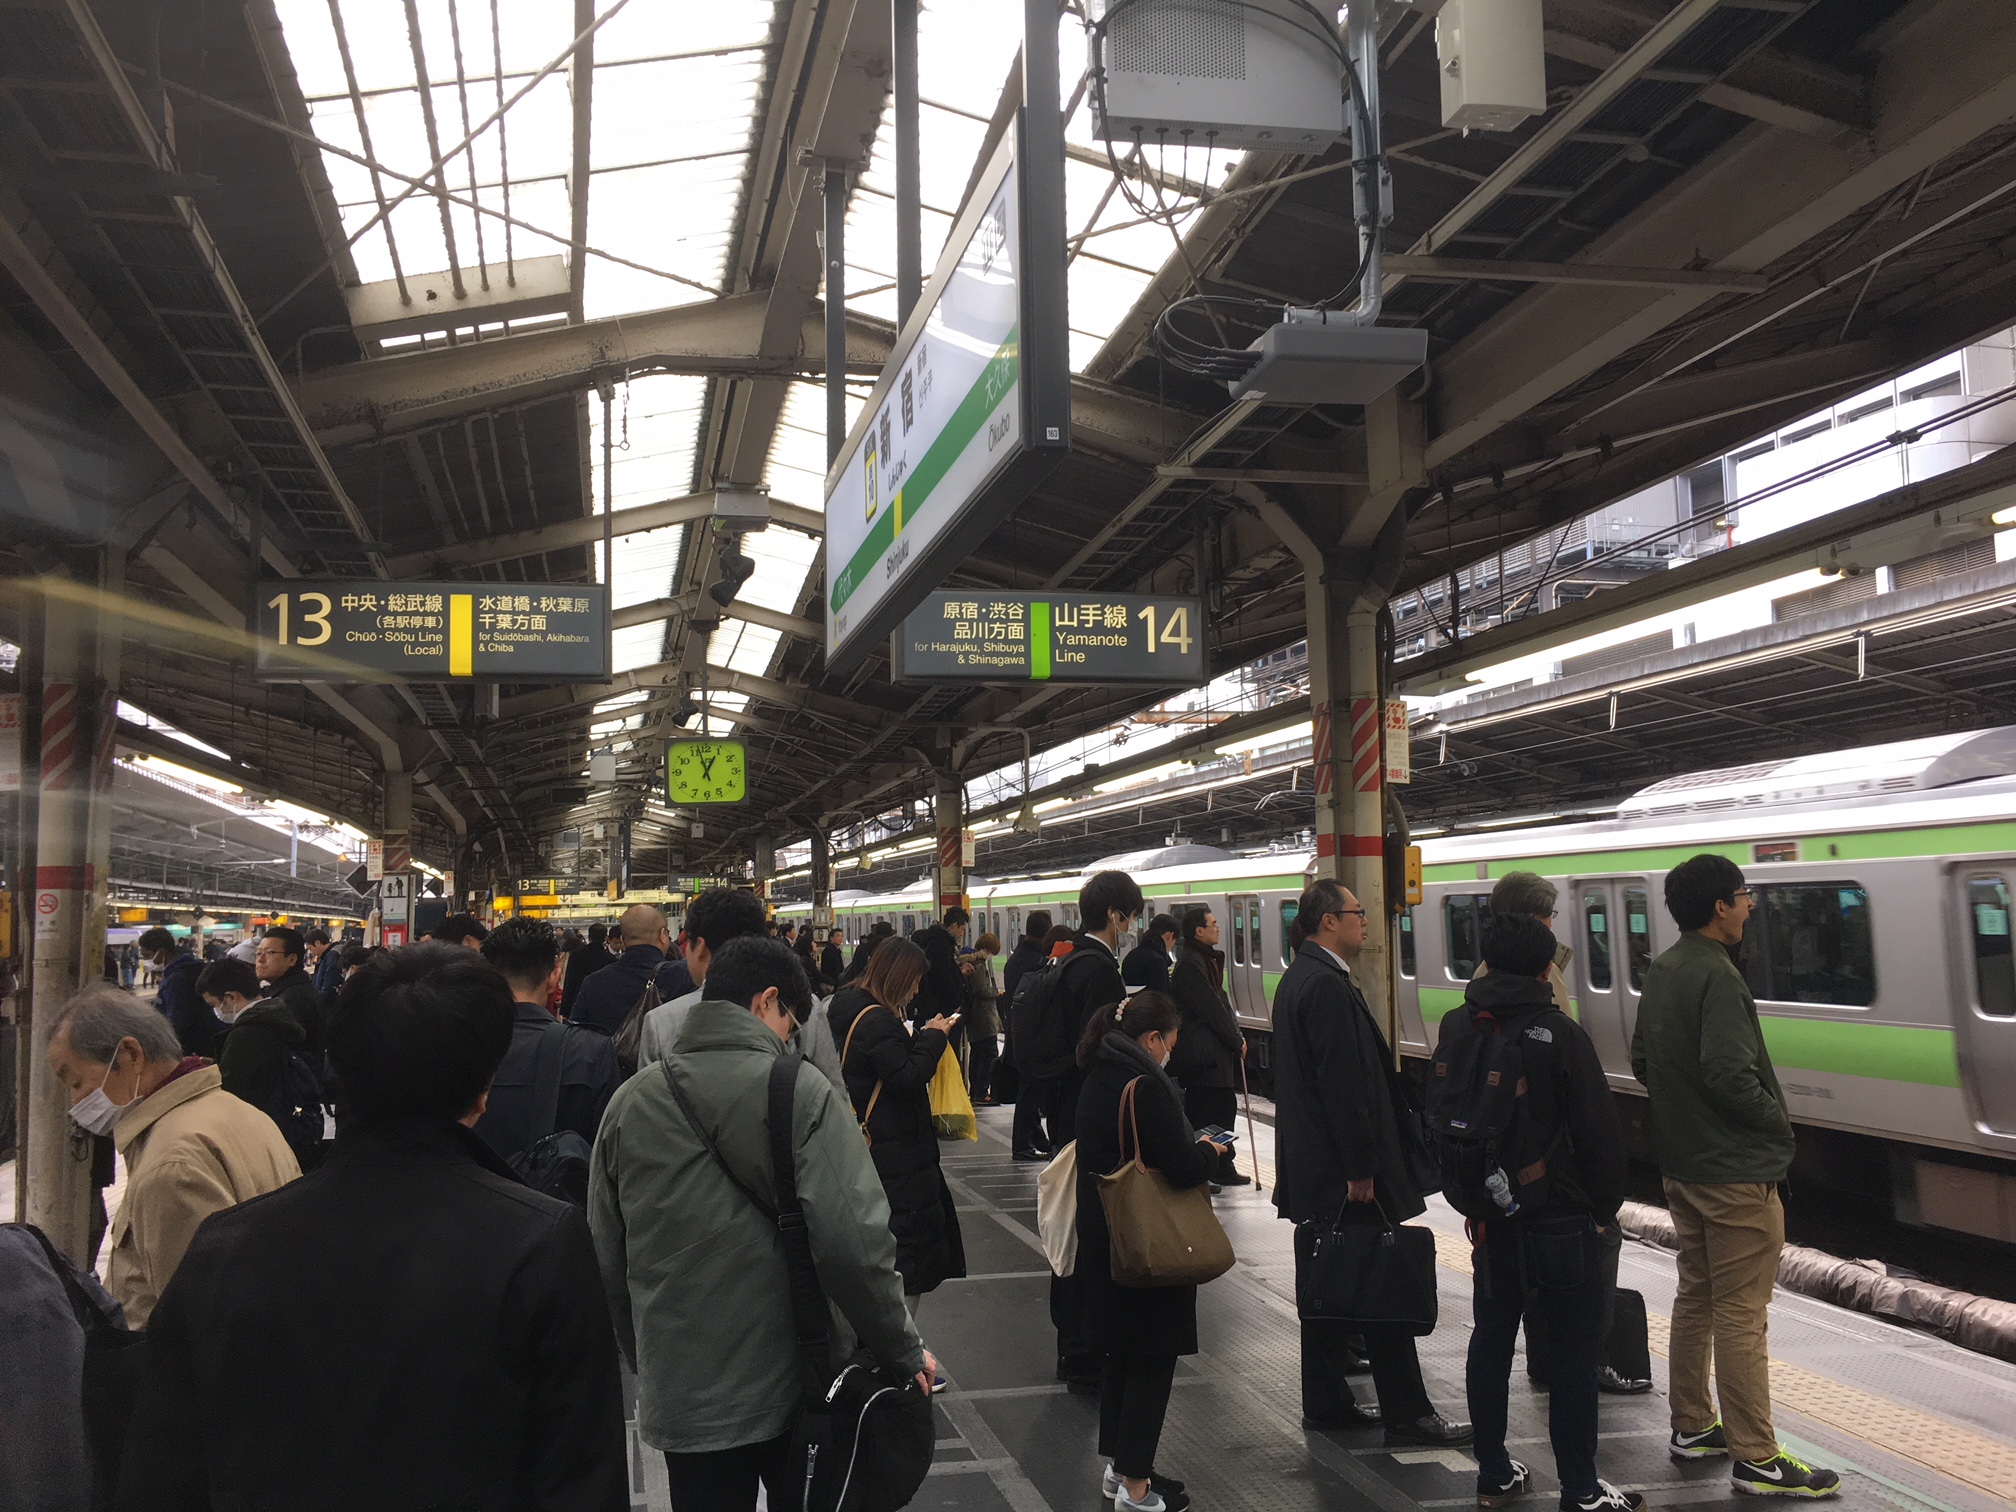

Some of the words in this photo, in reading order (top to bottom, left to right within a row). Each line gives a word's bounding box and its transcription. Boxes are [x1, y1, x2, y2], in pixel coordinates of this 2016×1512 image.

[985, 347, 1009, 410] 大久保
[880, 367, 914, 470] 新宿
[988, 413, 1011, 452] Ōkubo
[1047, 429, 1058, 438] 163
[888, 449, 907, 492] しんじゅく
[887, 539, 909, 580] Shinjuku
[341, 594, 443, 612] 中央・総武線
[479, 595, 590, 613] 水道橋・秋葉原
[943, 602, 1024, 620] 原宿・渋谷
[1055, 603, 1128, 629] 山手線
[267, 592, 332, 646] 13
[479, 614, 547, 631] 千葉方面
[954, 623, 1025, 640] 品川方面
[1137, 605, 1193, 654] 14
[420, 632, 443, 642] Line
[479, 632, 491, 642] for
[546, 633, 590, 643] Akihabara
[1056, 631, 1128, 647] Yamanote
[404, 645, 443, 656] (Local)
[479, 643, 486, 652] &
[488, 643, 514, 653] Chiba
[914, 642, 929, 652] for
[931, 642, 981, 655] Harajuku,
[983, 643, 1025, 656] Shibuya
[957, 654, 966, 665] &
[968, 654, 1025, 667] Shinagawa
[1055, 649, 1086, 663] Line
[690, 749, 700, 757] 11
[701, 745, 711, 753] 12
[680, 757, 690, 765] 10
[726, 755, 733, 763] 2
[731, 767, 738, 775] 3
[680, 781, 688, 789] 8
[692, 789, 699, 797] 7
[703, 791, 711, 799] 6
[715, 788, 722, 796] 5
[517, 879, 530, 891] 13
[716, 877, 728, 888] 14
